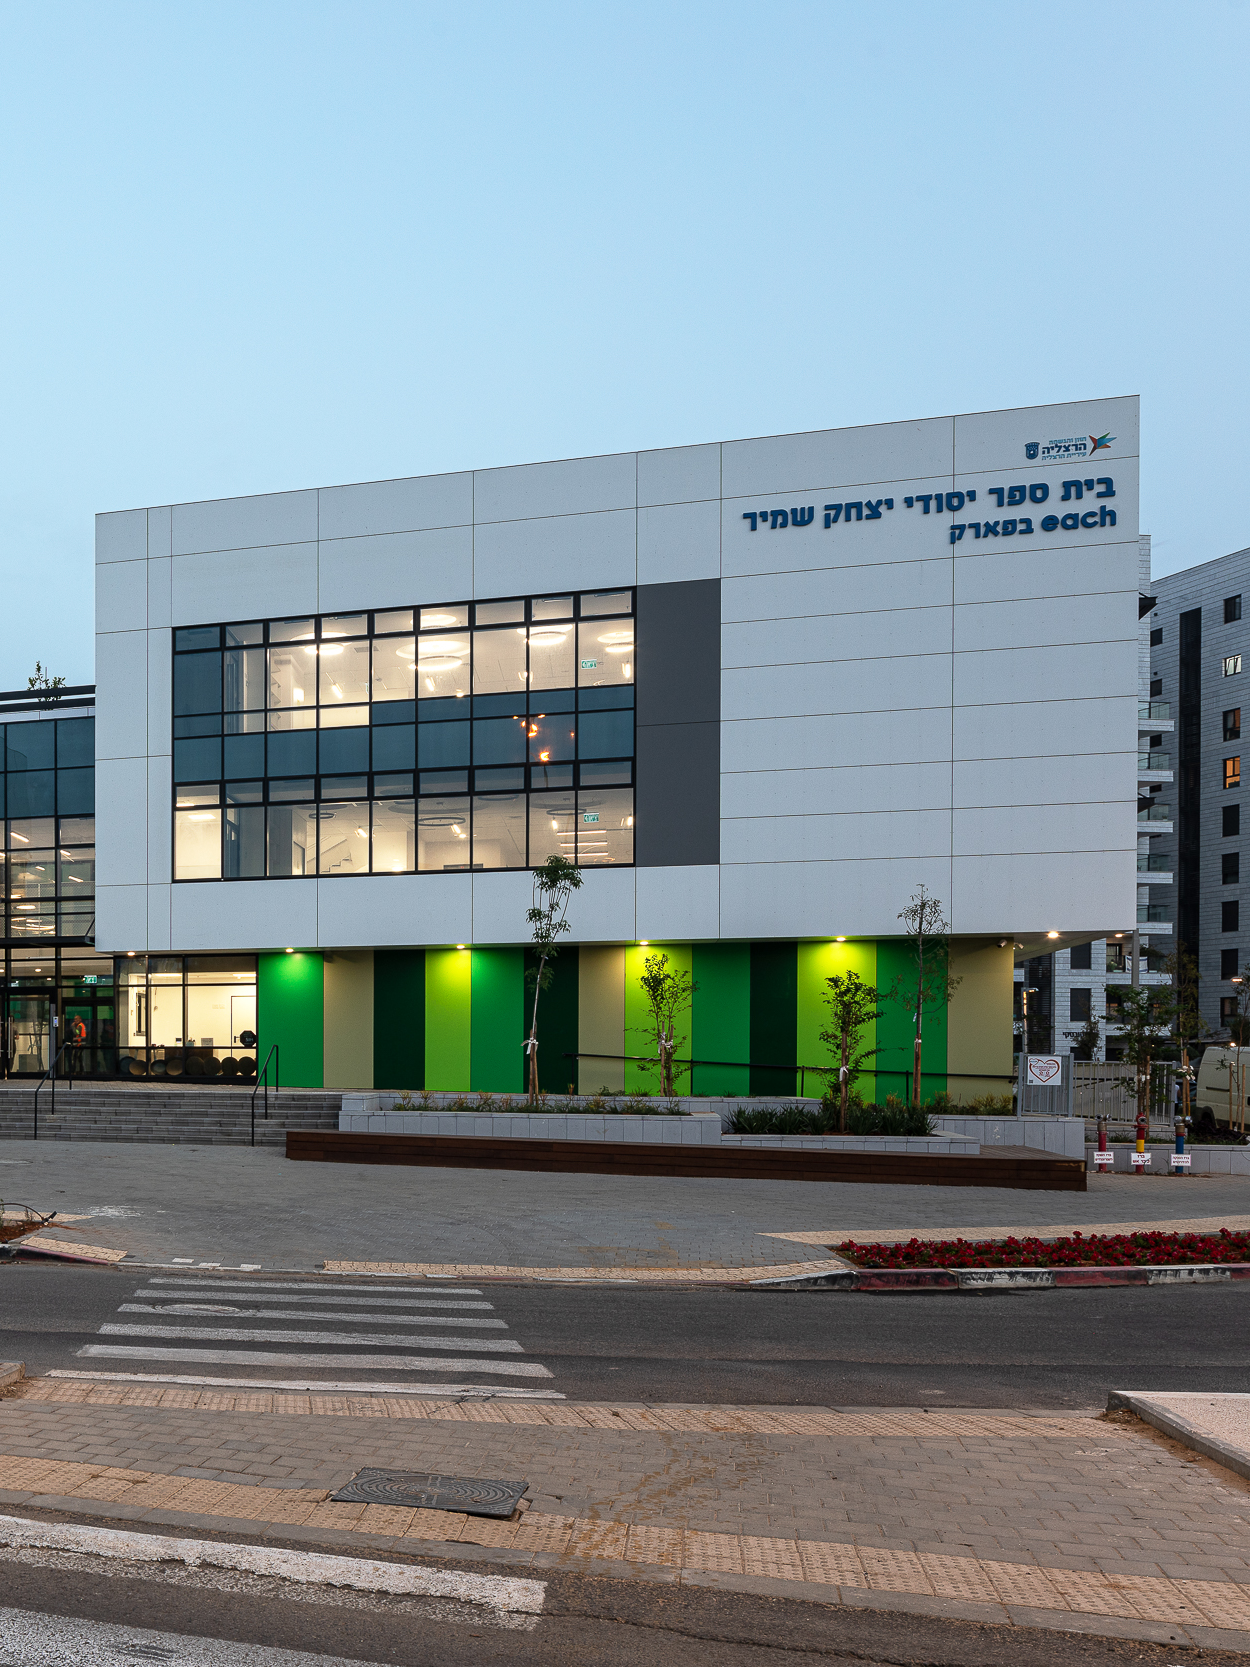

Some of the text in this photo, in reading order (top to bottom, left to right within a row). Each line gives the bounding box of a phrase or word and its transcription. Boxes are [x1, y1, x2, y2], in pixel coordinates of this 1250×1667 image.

[1042, 443, 1087, 455] הרצליה
[742, 477, 1116, 531] בית ספר יסודי יצחק שמיר
[950, 505, 1117, 544] each בפארק
